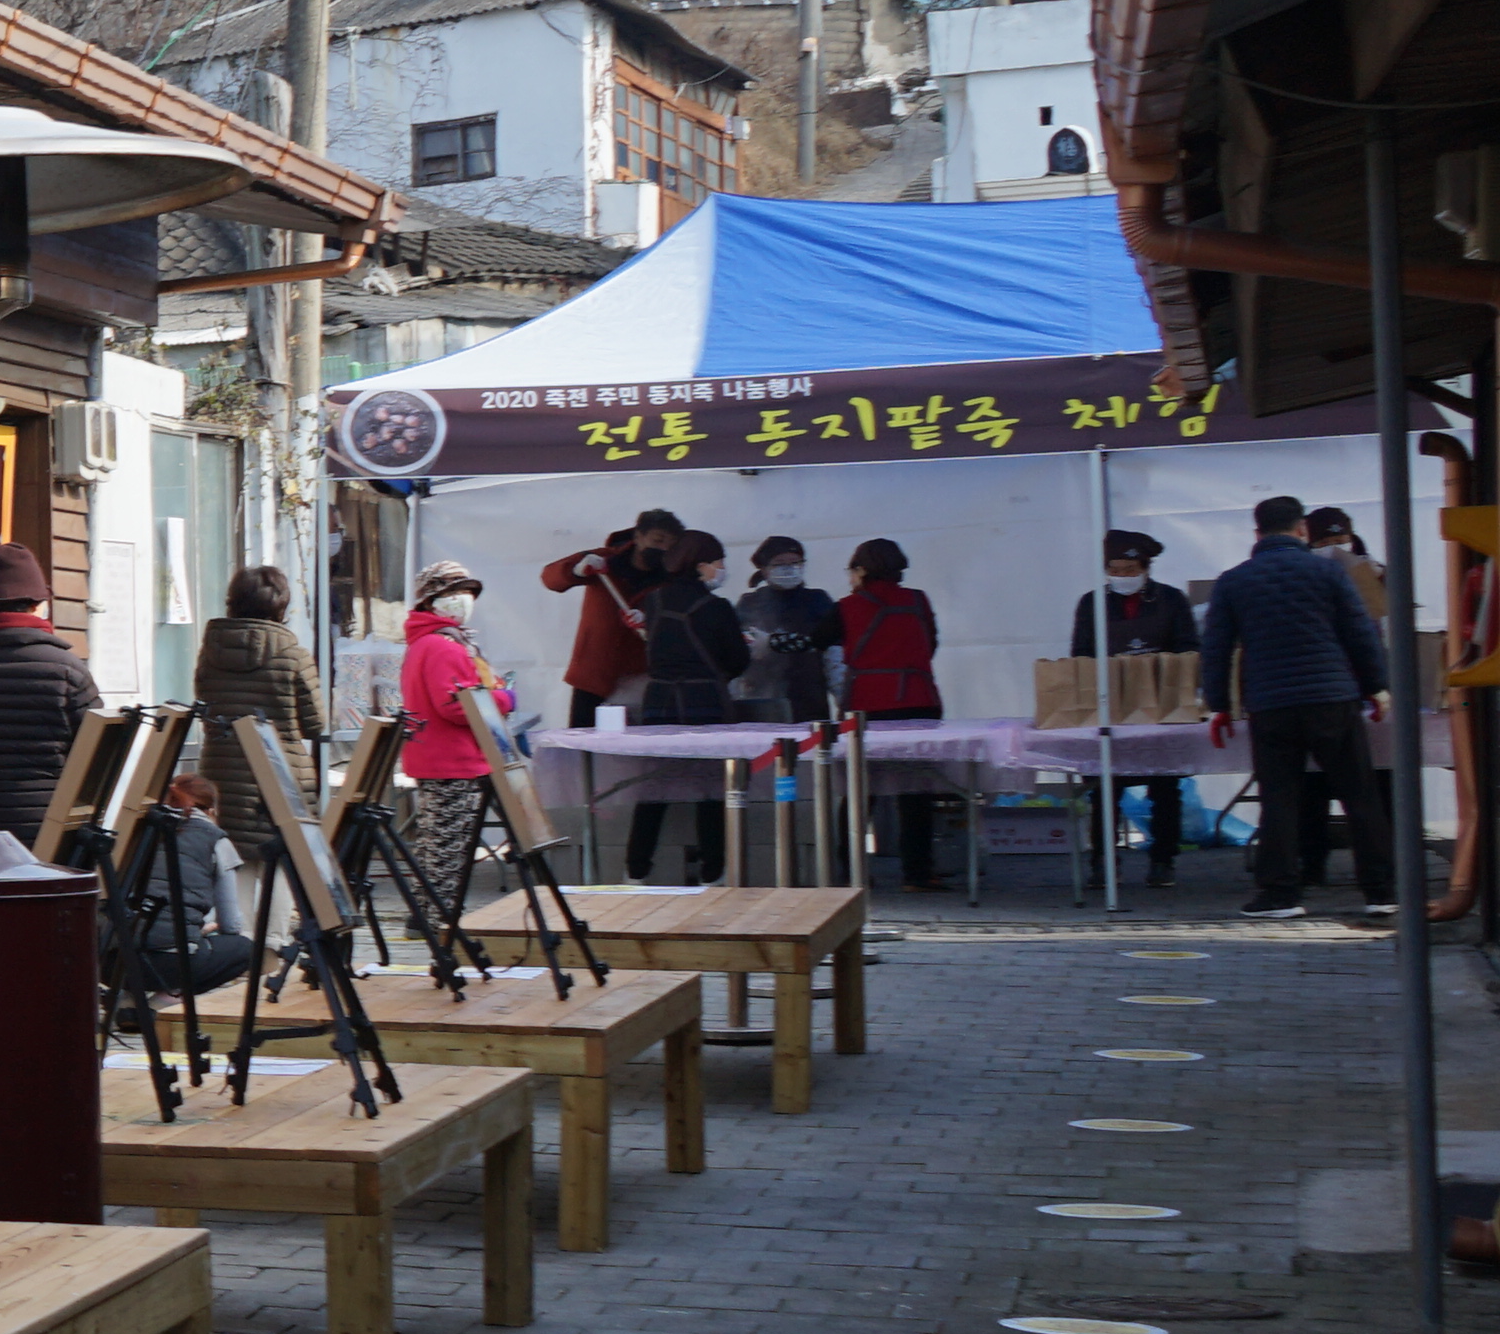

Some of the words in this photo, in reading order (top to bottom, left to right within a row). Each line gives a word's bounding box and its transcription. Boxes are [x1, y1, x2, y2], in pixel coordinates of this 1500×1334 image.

[480, 391, 538, 409] 2020
[545, 388, 589, 409] 죽전
[595, 386, 640, 407] 주민
[648, 382, 713, 405] 동지죽
[722, 375, 813, 401] 나눔행사
[578, 410, 709, 461] 전통
[745, 395, 1021, 459] 동지팥죽
